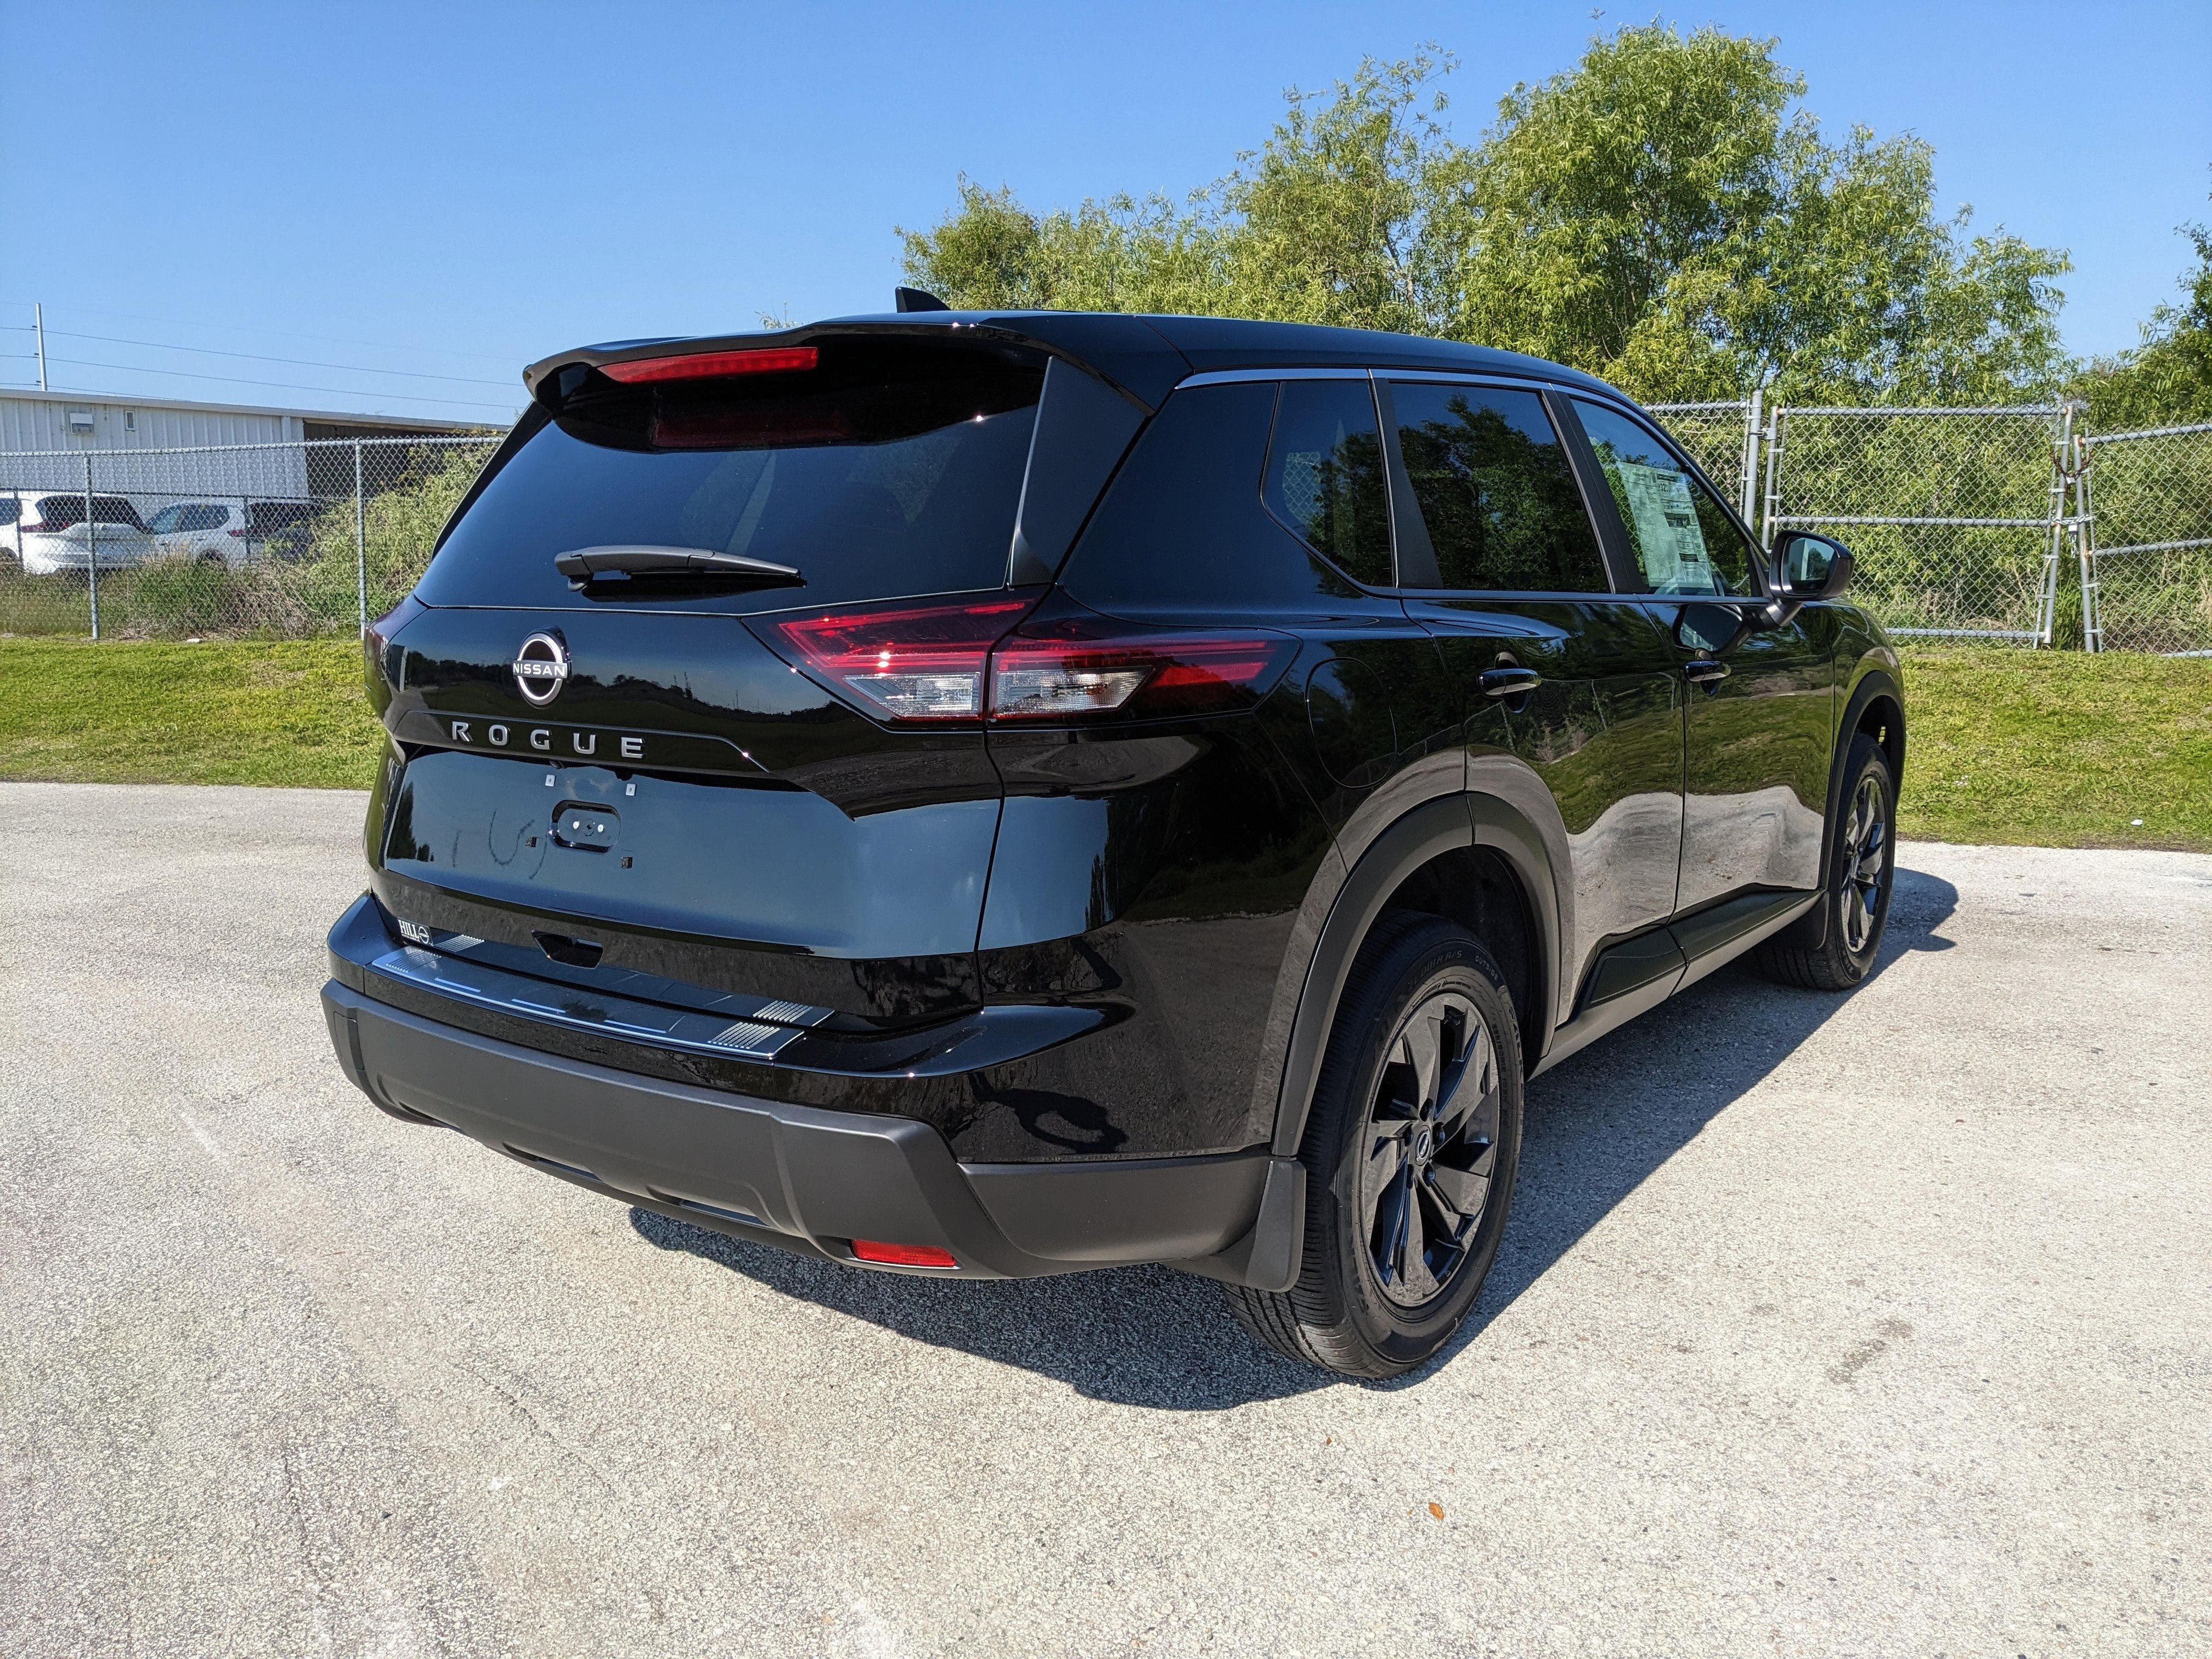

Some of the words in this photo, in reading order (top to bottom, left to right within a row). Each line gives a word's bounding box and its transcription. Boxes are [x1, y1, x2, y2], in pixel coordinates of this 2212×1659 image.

[513, 663, 566, 676] NISSAN
[452, 721, 644, 758] ROGUE
[398, 919, 420, 939] HILL
[1475, 955, 1498, 981] OUTSIDE
